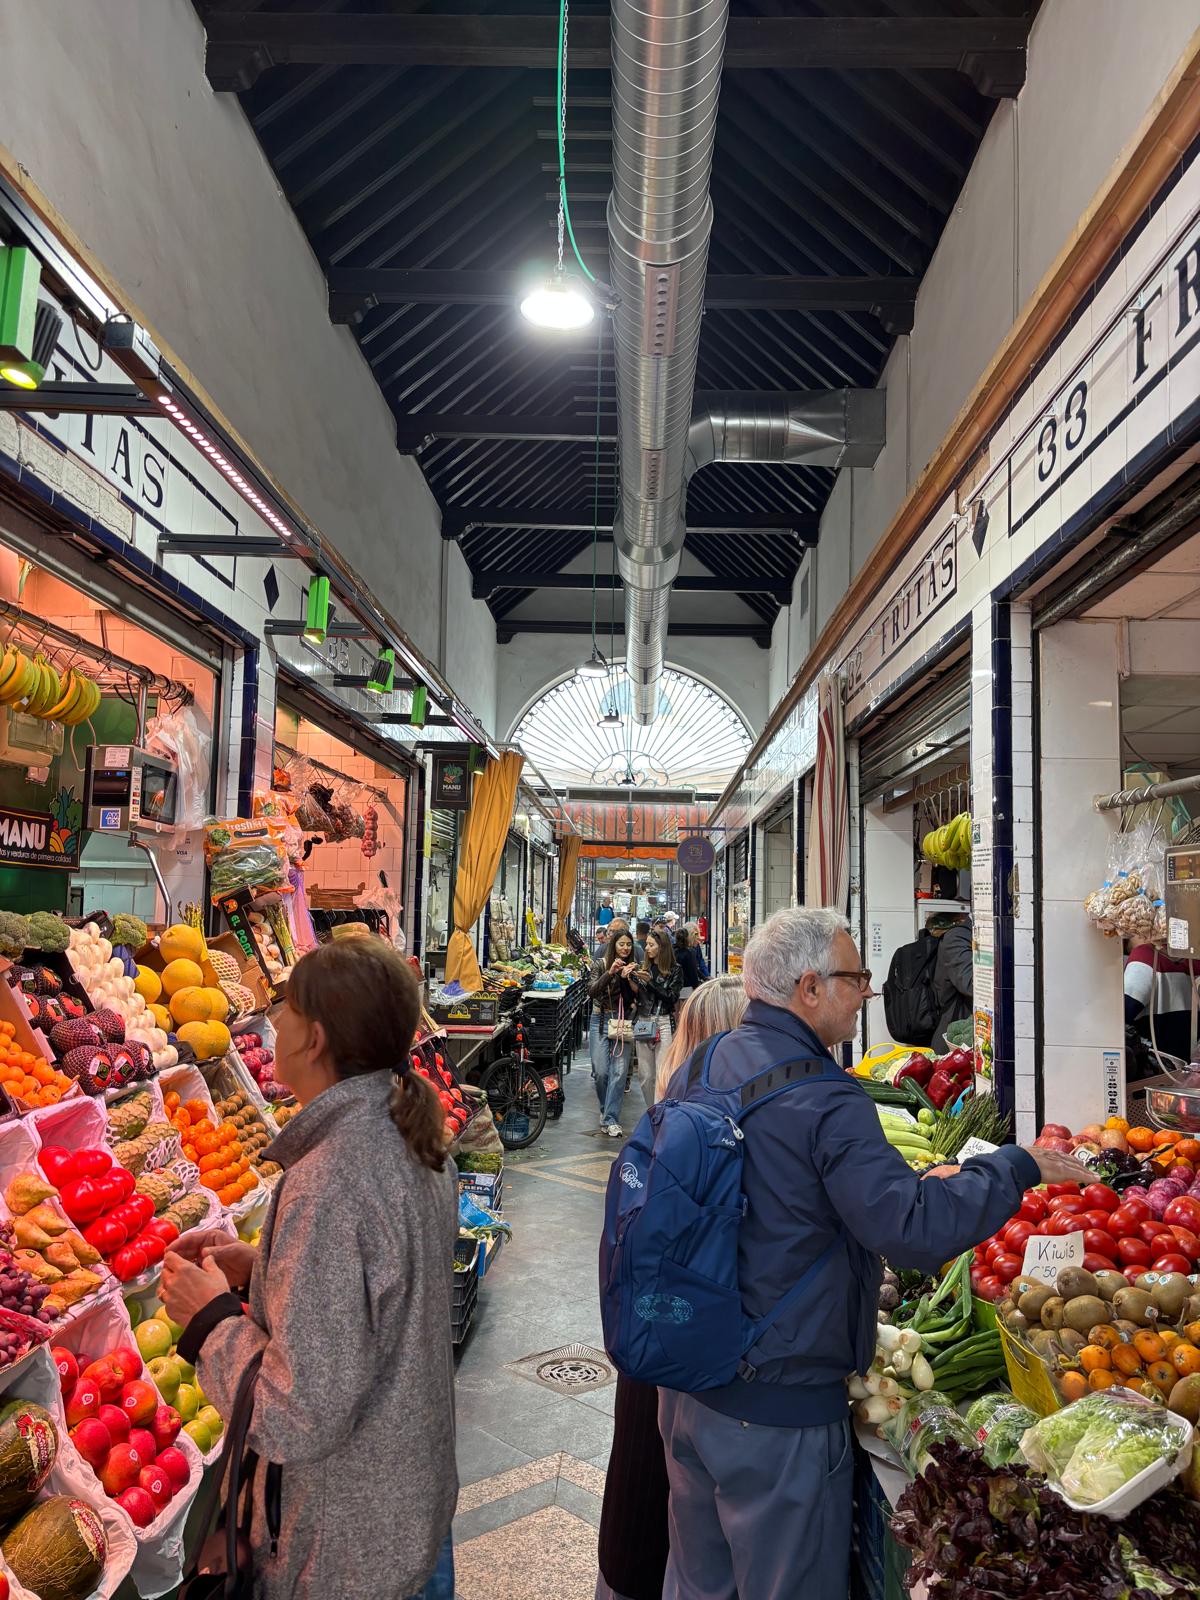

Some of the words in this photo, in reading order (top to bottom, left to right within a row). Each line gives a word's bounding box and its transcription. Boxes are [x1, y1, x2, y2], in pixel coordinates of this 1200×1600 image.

[1038, 380, 1088, 483] 33
[848, 651, 863, 691] 32
[881, 537, 955, 657] FRUTAS
[106, 811, 120, 819] AM
[0, 818, 46, 850] MANU
[55, 855, 72, 863] calidad
[231, 914, 241, 927] EL
[1038, 1240, 1075, 1262] Kiwis
